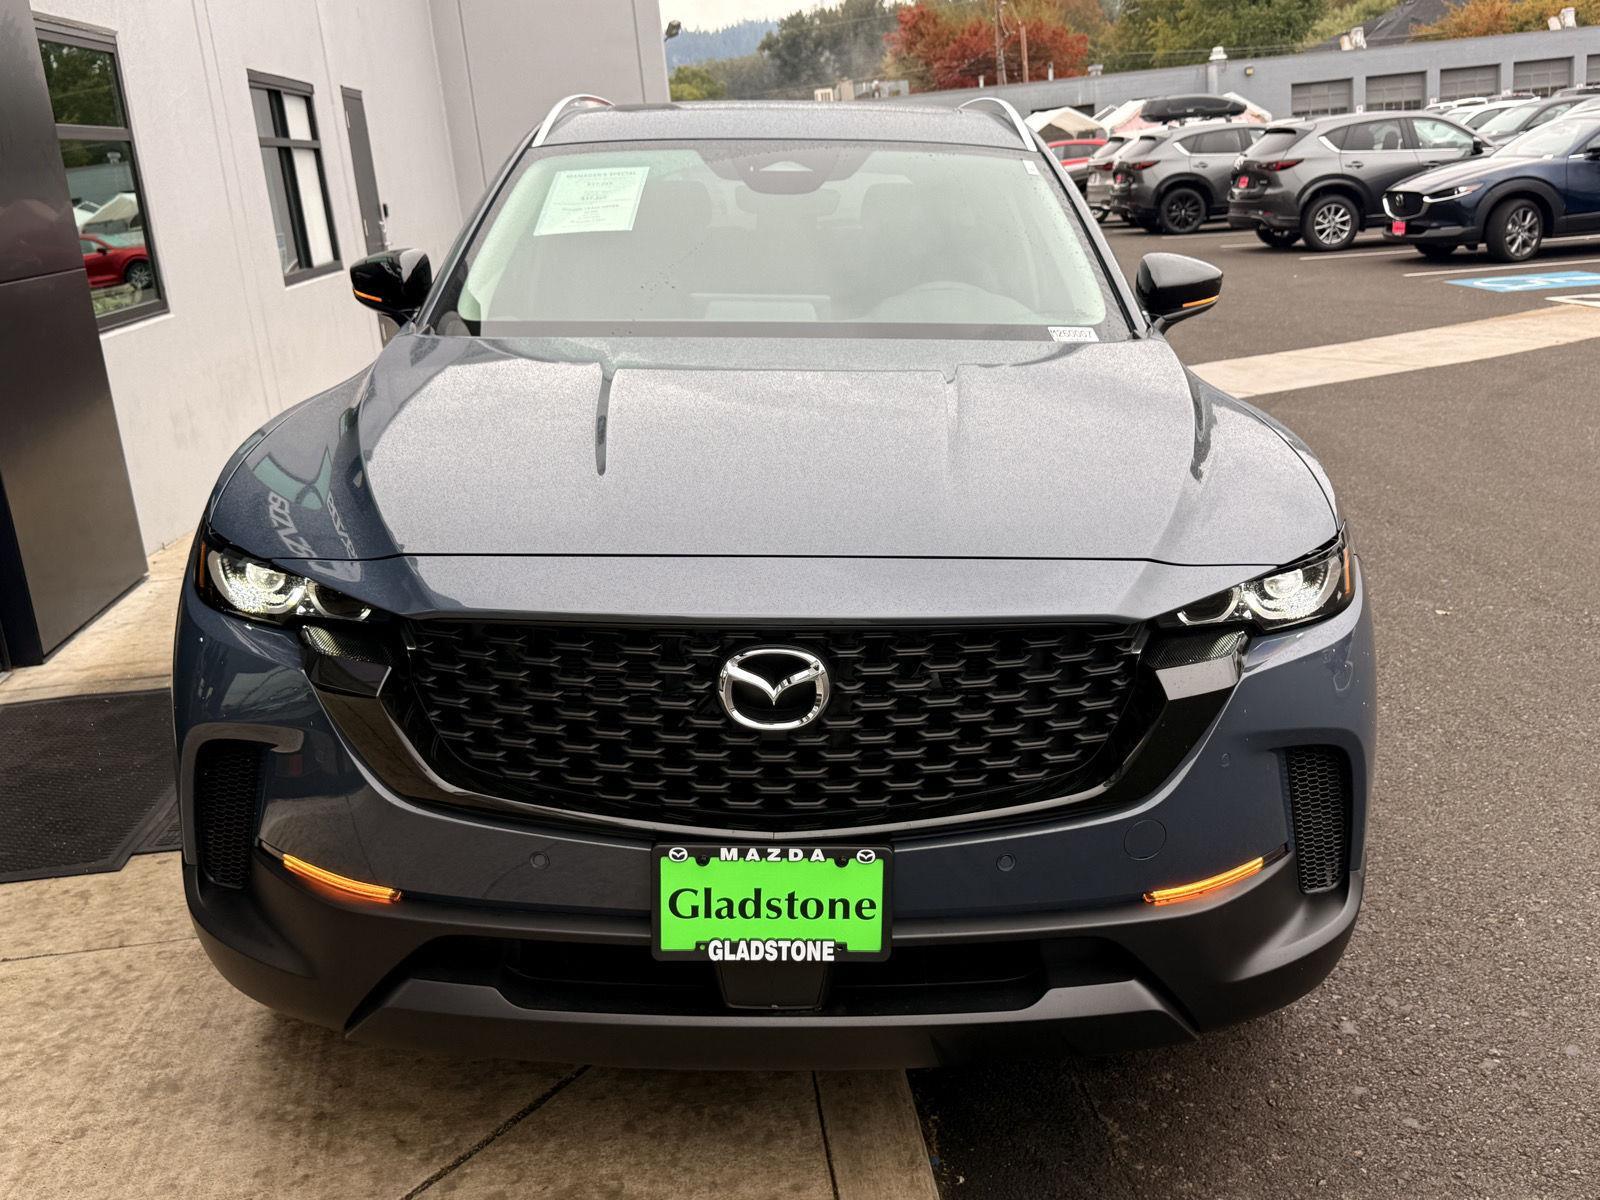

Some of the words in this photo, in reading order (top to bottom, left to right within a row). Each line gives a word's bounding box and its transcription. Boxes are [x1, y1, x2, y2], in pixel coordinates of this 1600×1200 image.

[719, 847, 826, 862] MAZDA
[668, 887, 877, 921] Gladstone
[708, 940, 835, 962] GLADSTONE
